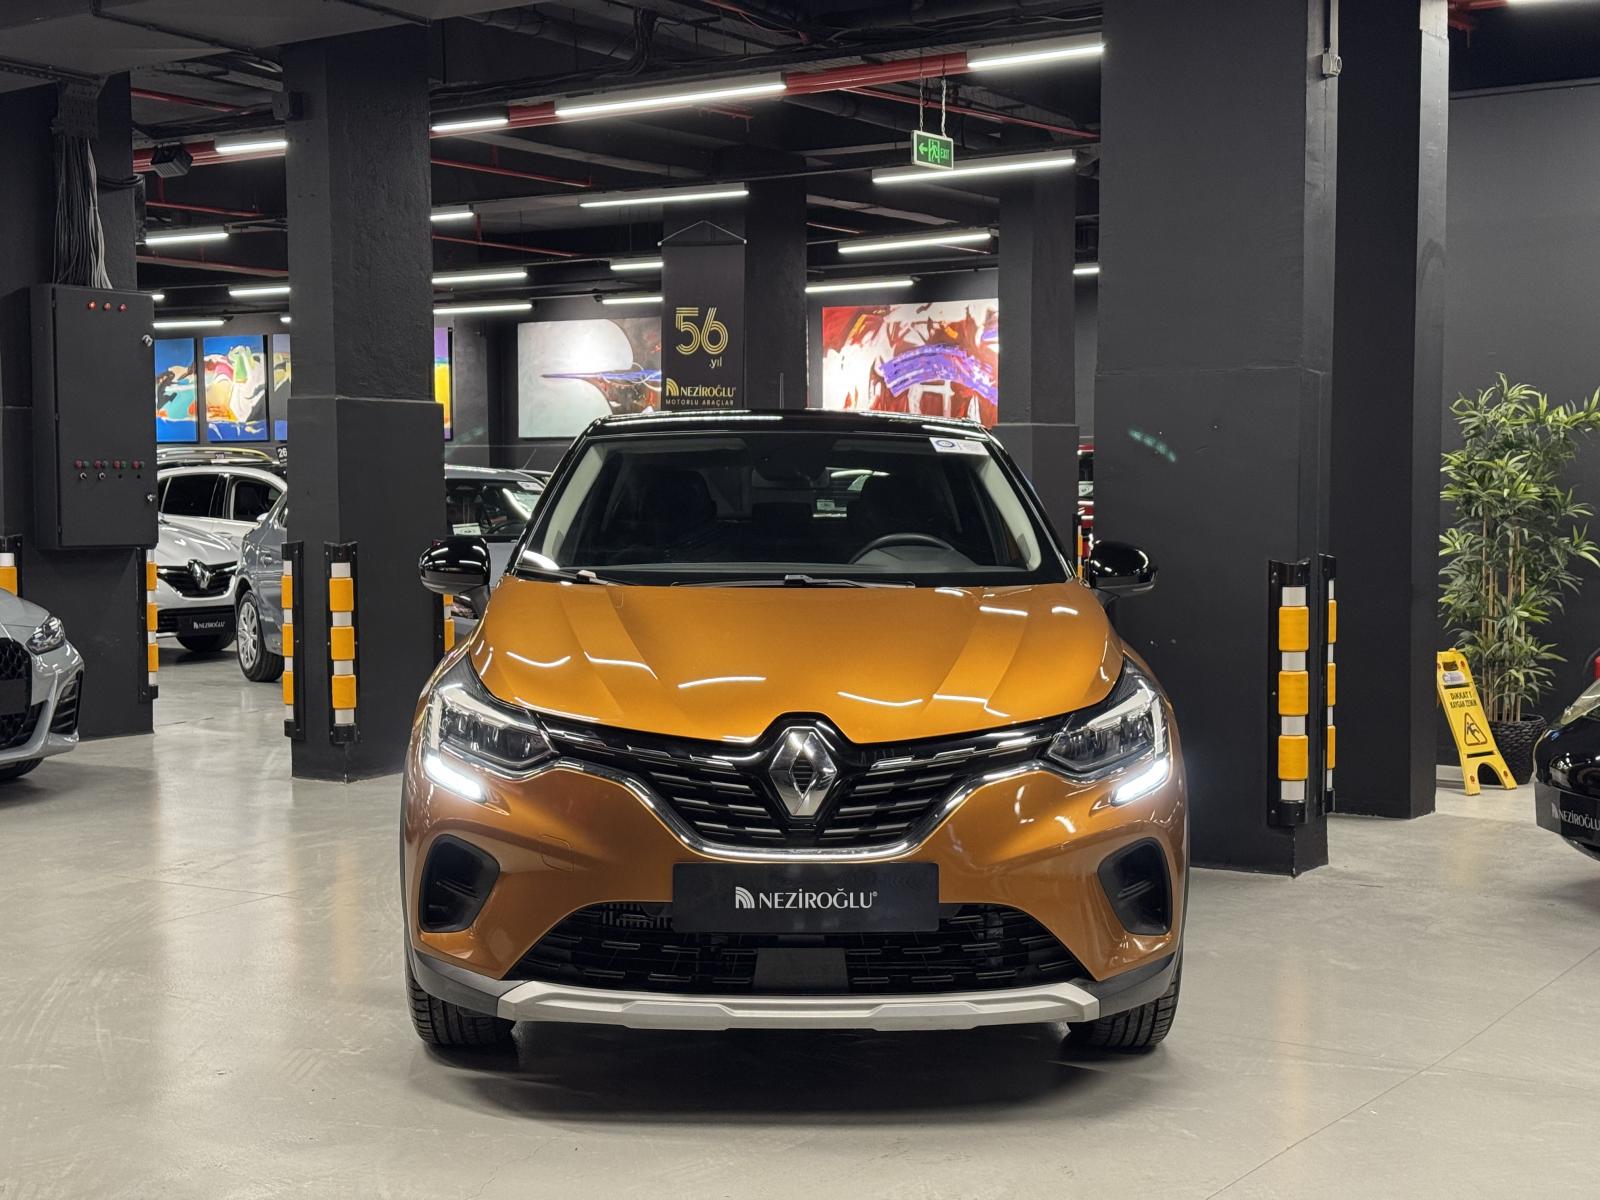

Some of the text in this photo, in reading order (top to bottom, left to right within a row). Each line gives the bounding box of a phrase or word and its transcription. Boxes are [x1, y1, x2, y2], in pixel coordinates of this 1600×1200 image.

[941, 147, 950, 160] EXIT
[675, 307, 729, 356] 56
[665, 398, 734, 407] MOTORLU ARAÇLAR
